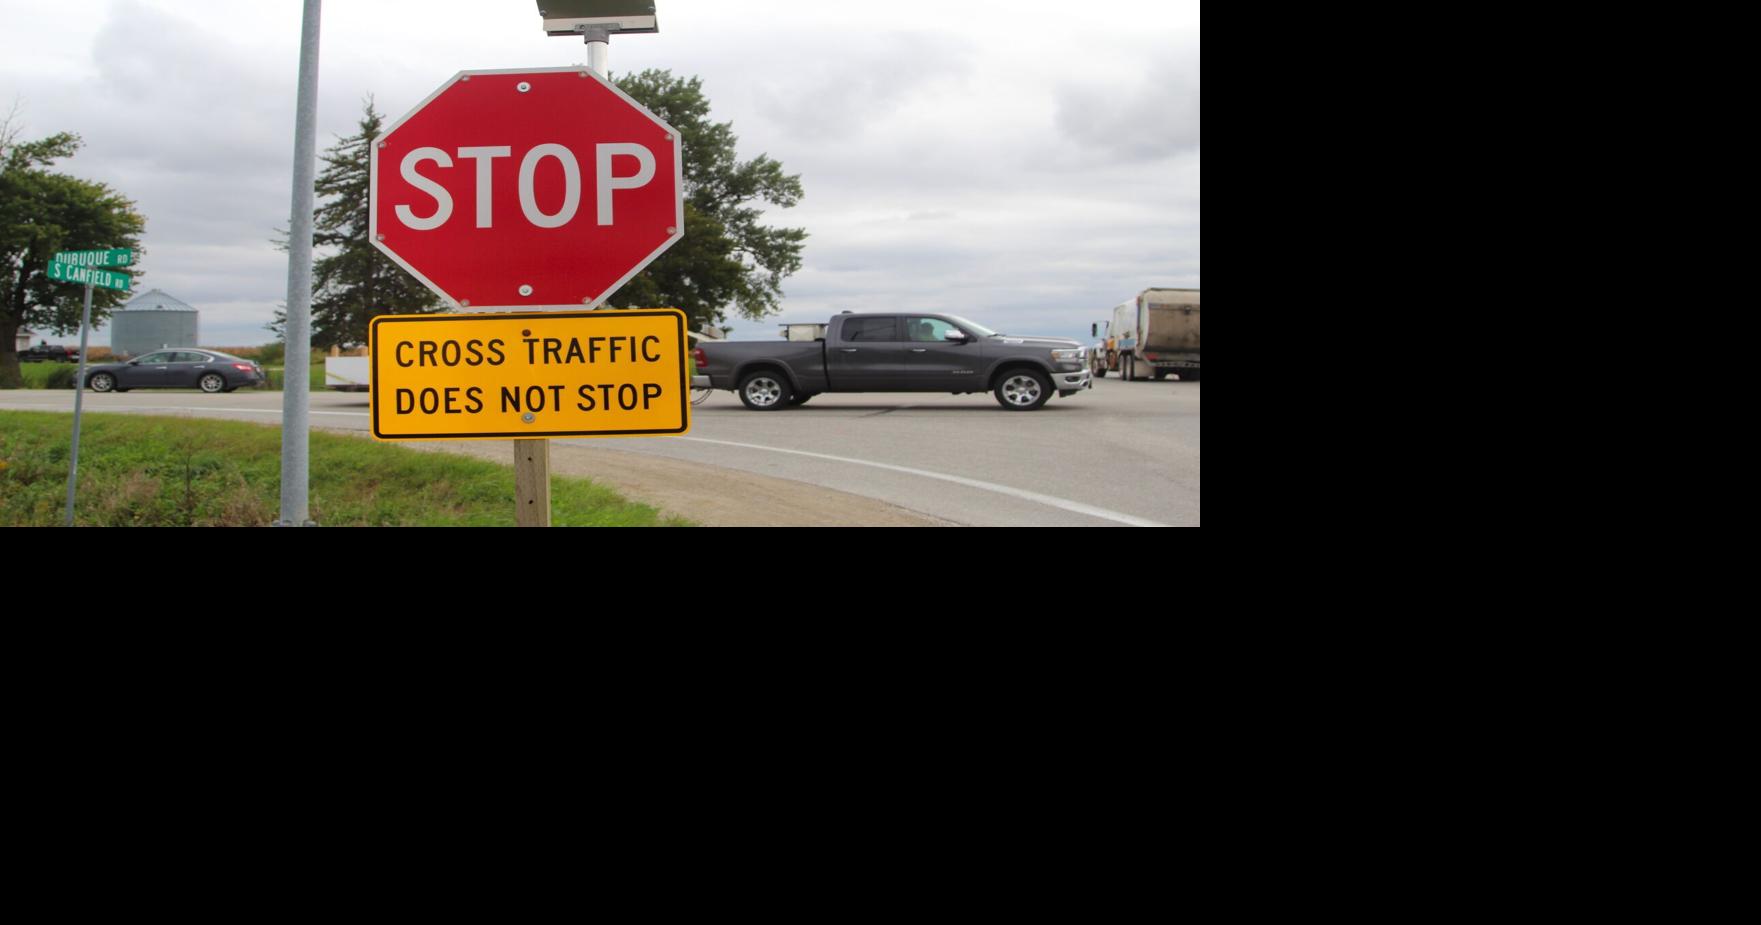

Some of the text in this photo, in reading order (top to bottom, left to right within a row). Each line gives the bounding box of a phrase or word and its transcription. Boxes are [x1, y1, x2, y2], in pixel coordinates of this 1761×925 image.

[394, 142, 657, 231] STOP
[55, 251, 128, 266] DUBUQUE RD
[54, 263, 124, 289] S CANFIELD RD
[395, 335, 661, 367] CROSS TRAFFIC
[396, 383, 663, 415] DOES NOT STOP
